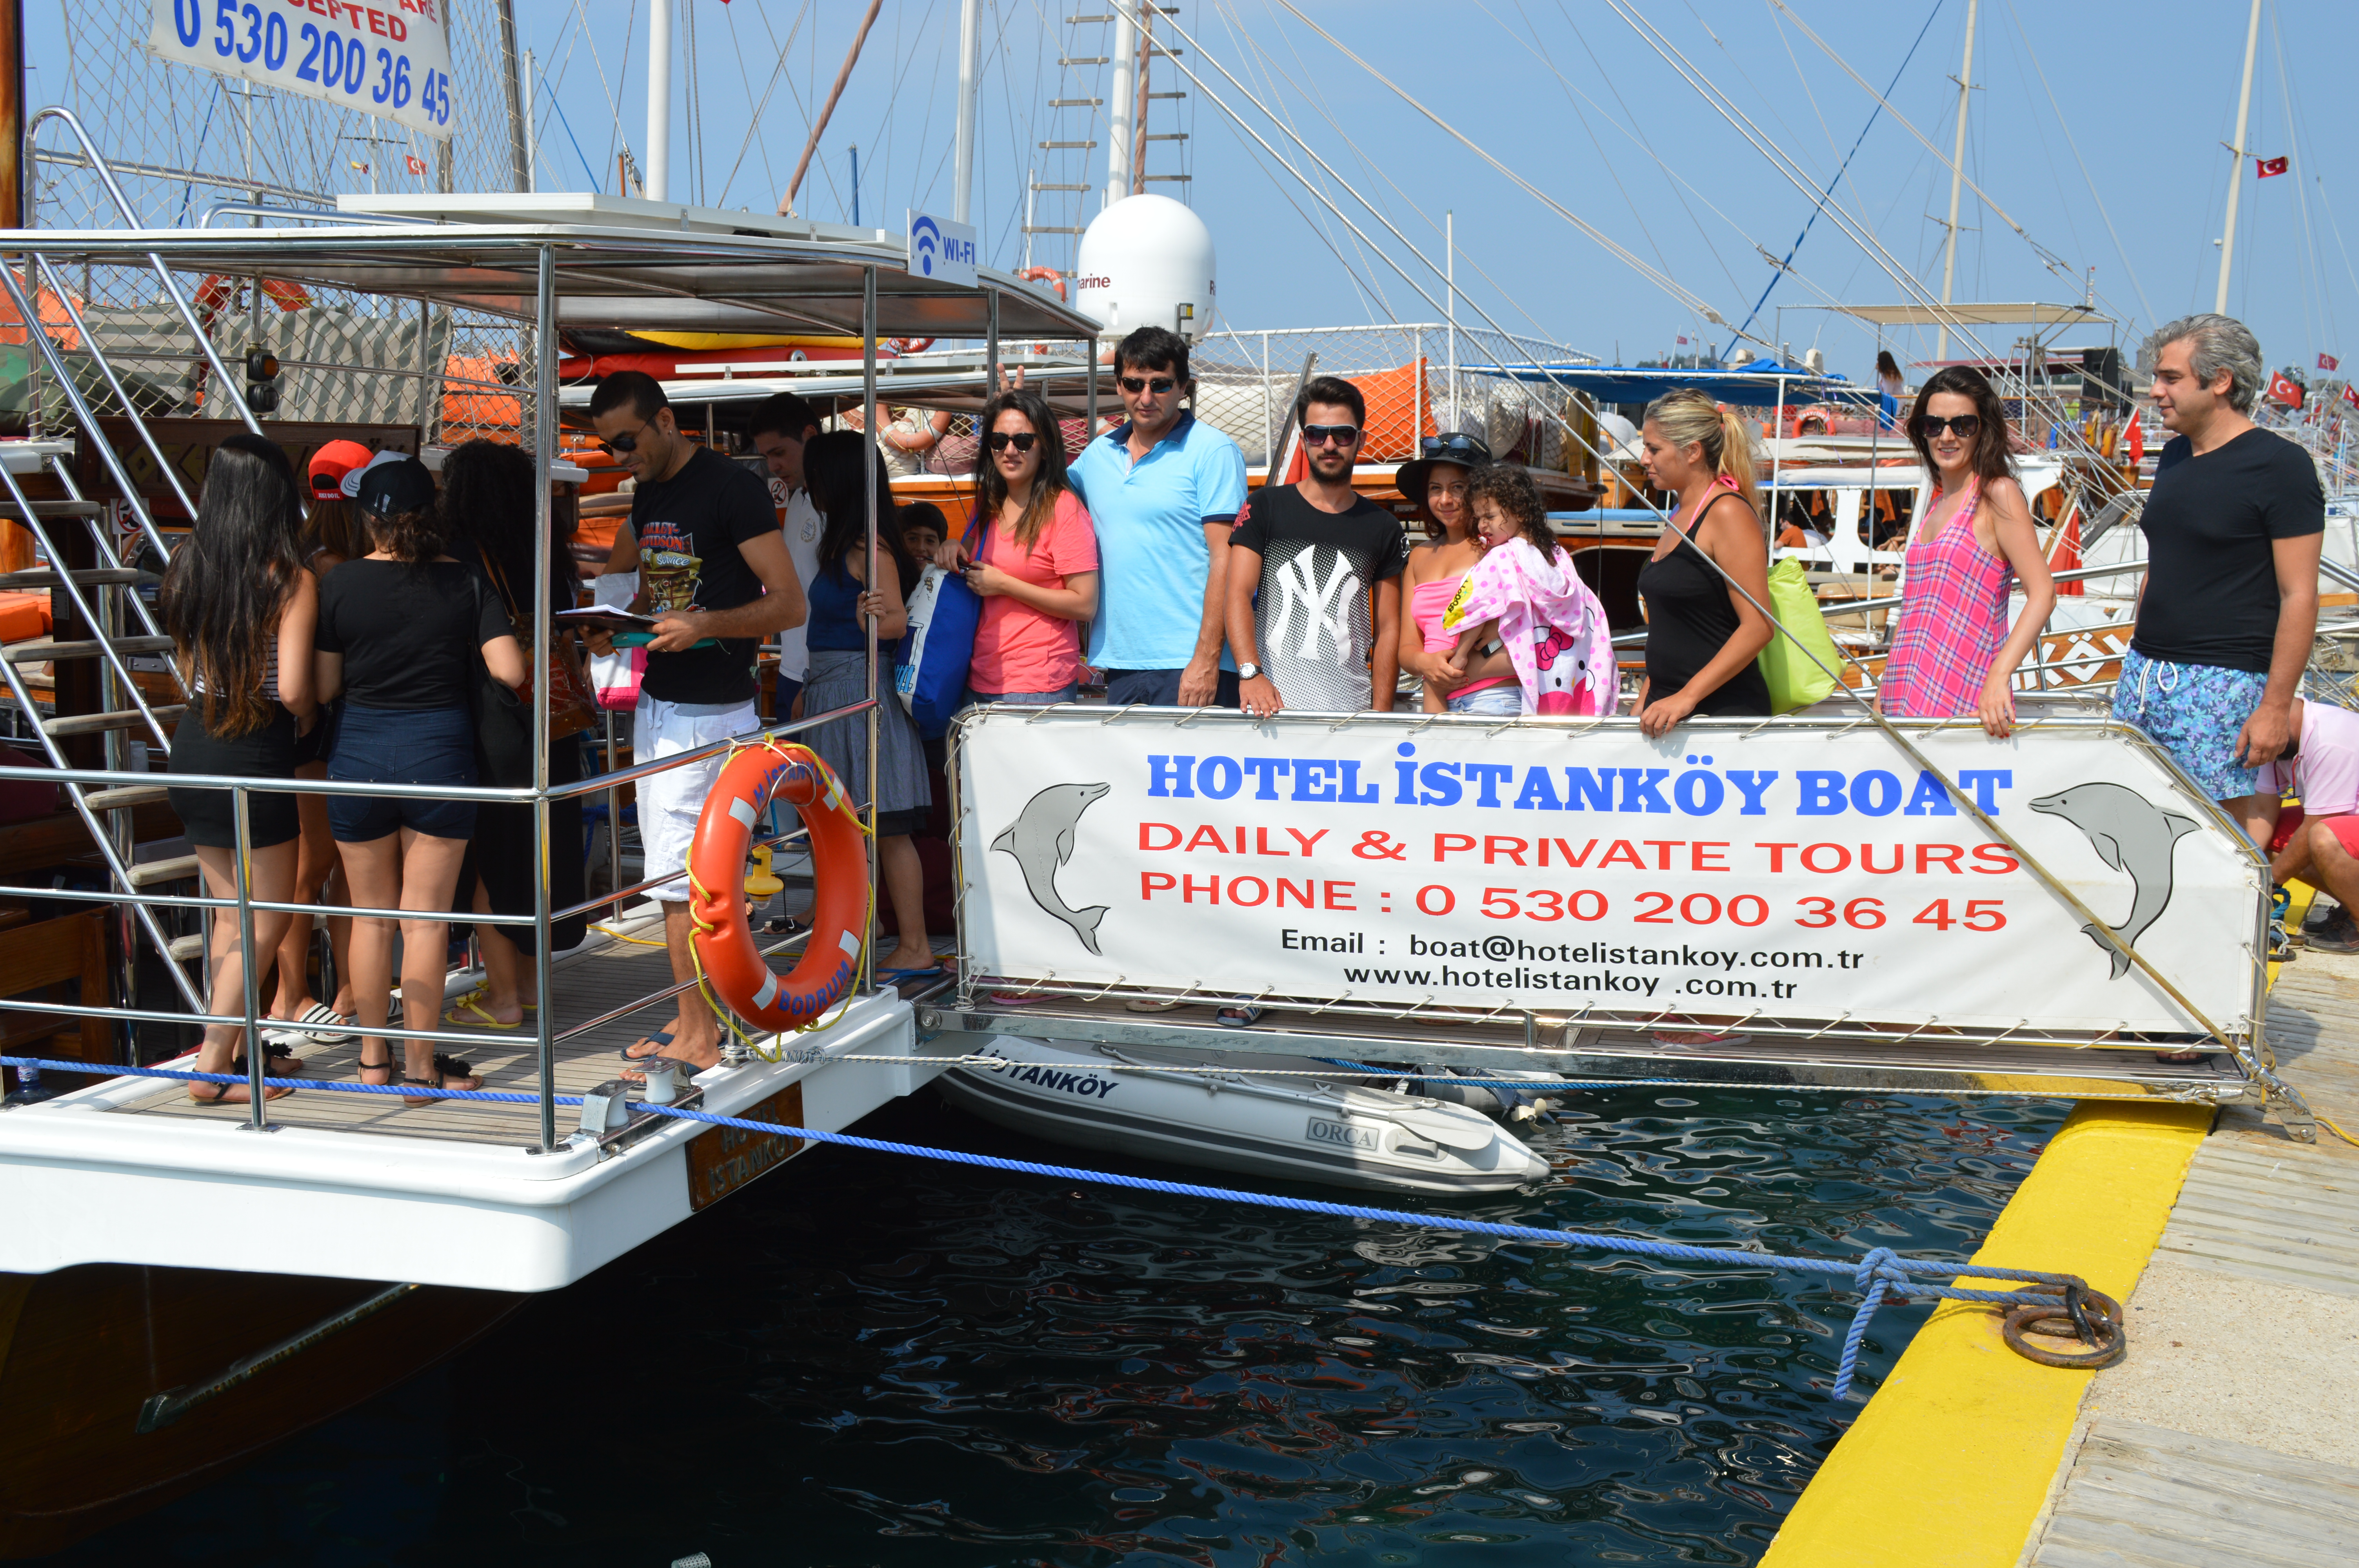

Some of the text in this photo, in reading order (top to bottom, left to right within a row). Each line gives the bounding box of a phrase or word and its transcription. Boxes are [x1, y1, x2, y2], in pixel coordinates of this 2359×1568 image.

[287, 0, 407, 42] EPTED
[174, 0, 450, 126] 0 530 200 36 45
[943, 236, 975, 265] WI-FI
[656, 553, 691, 566] Service
[1147, 742, 2013, 817] HOTEL İSTANKÖY BOAT
[1139, 822, 2019, 875] DAILY & PRIVATE TOURS
[1141, 871, 1357, 911] PHONE
[1416, 885, 1456, 916] 0
[1480, 887, 1608, 922] 530
[1634, 891, 1769, 927] 200
[1795, 897, 1886, 929] 36
[1913, 899, 2007, 932] 45
[1281, 929, 1363, 953] Email
[1410, 934, 1864, 971] boat@hotelistankoy.com.tr
[778, 959, 850, 1015] BODRUM
[1343, 965, 1797, 999] www.hotelistankoy .com.tr
[1312, 1122, 1372, 1147] ORCA
